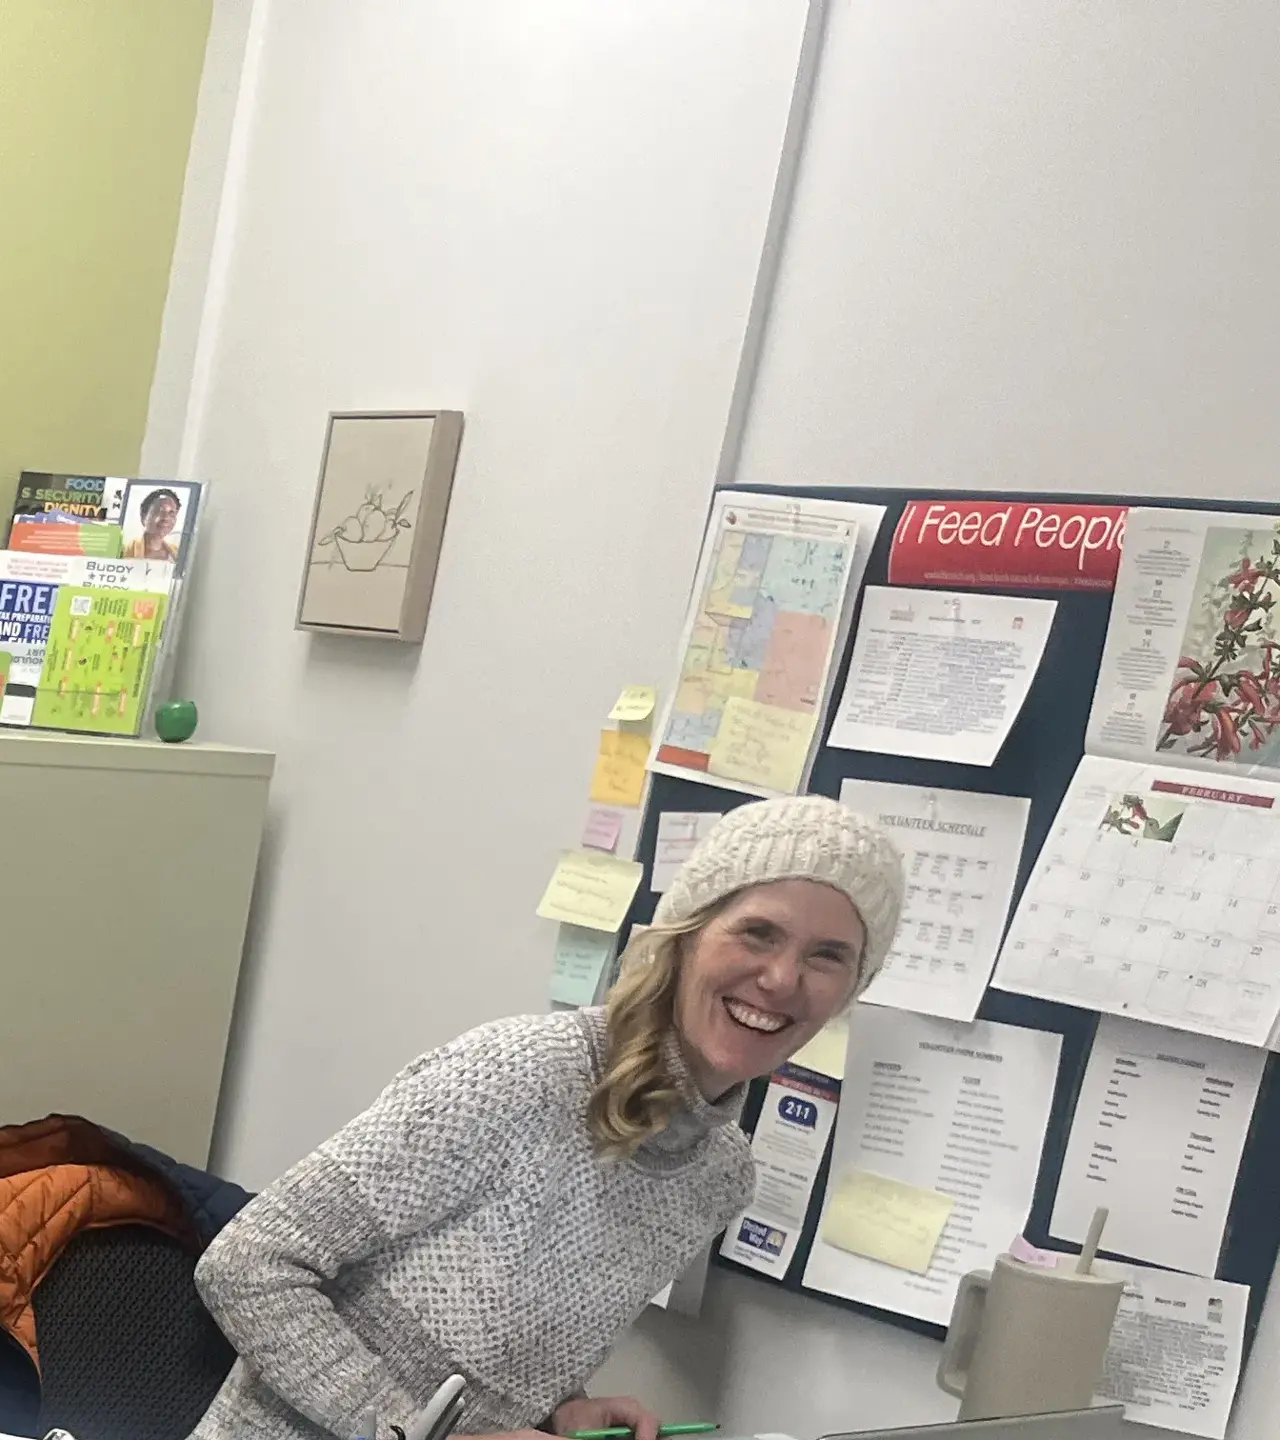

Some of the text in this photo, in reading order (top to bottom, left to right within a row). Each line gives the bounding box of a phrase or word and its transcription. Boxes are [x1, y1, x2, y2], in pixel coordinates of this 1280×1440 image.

[65, 477, 106, 492] FOOD
[34, 489, 104, 504] SECURITY
[899, 505, 916, 543] I
[917, 505, 1012, 547] Feed
[99, 574, 116, 583] TO
[1181, 786, 1244, 803] FEBRUARY
